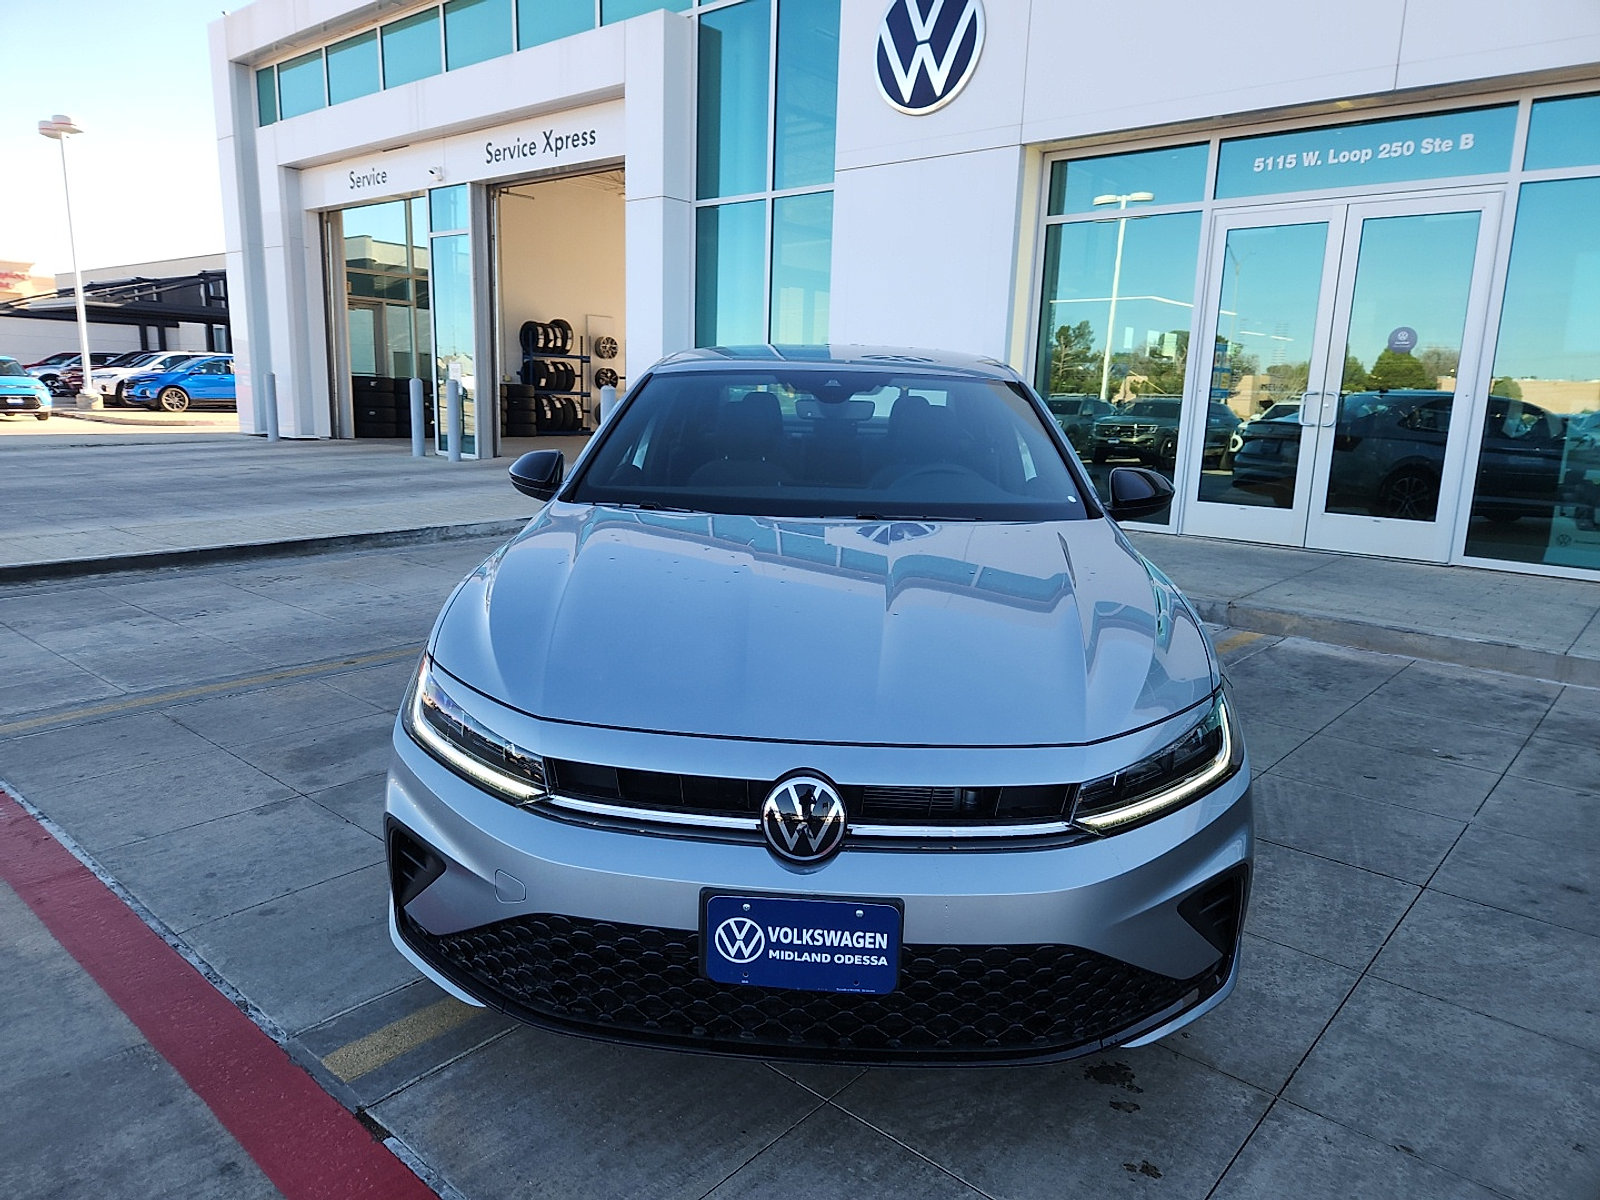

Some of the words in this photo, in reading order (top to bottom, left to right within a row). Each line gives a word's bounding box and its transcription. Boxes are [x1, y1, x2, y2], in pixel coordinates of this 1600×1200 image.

[485, 137, 537, 164] Service
[542, 129, 597, 159] Xpress
[1253, 154, 1297, 172] 5115
[1302, 150, 1322, 167] W.
[1328, 146, 1373, 164] Loop
[1378, 140, 1416, 159] 250
[1420, 137, 1452, 155] Ste
[1459, 133, 1475, 150] B
[349, 167, 388, 189] Service
[763, 776, 845, 861] VW
[715, 917, 765, 963] VW
[767, 926, 888, 949] VOLKSWAGEN
[768, 949, 831, 963] MIDLAND
[834, 954, 888, 966] ODESSA
